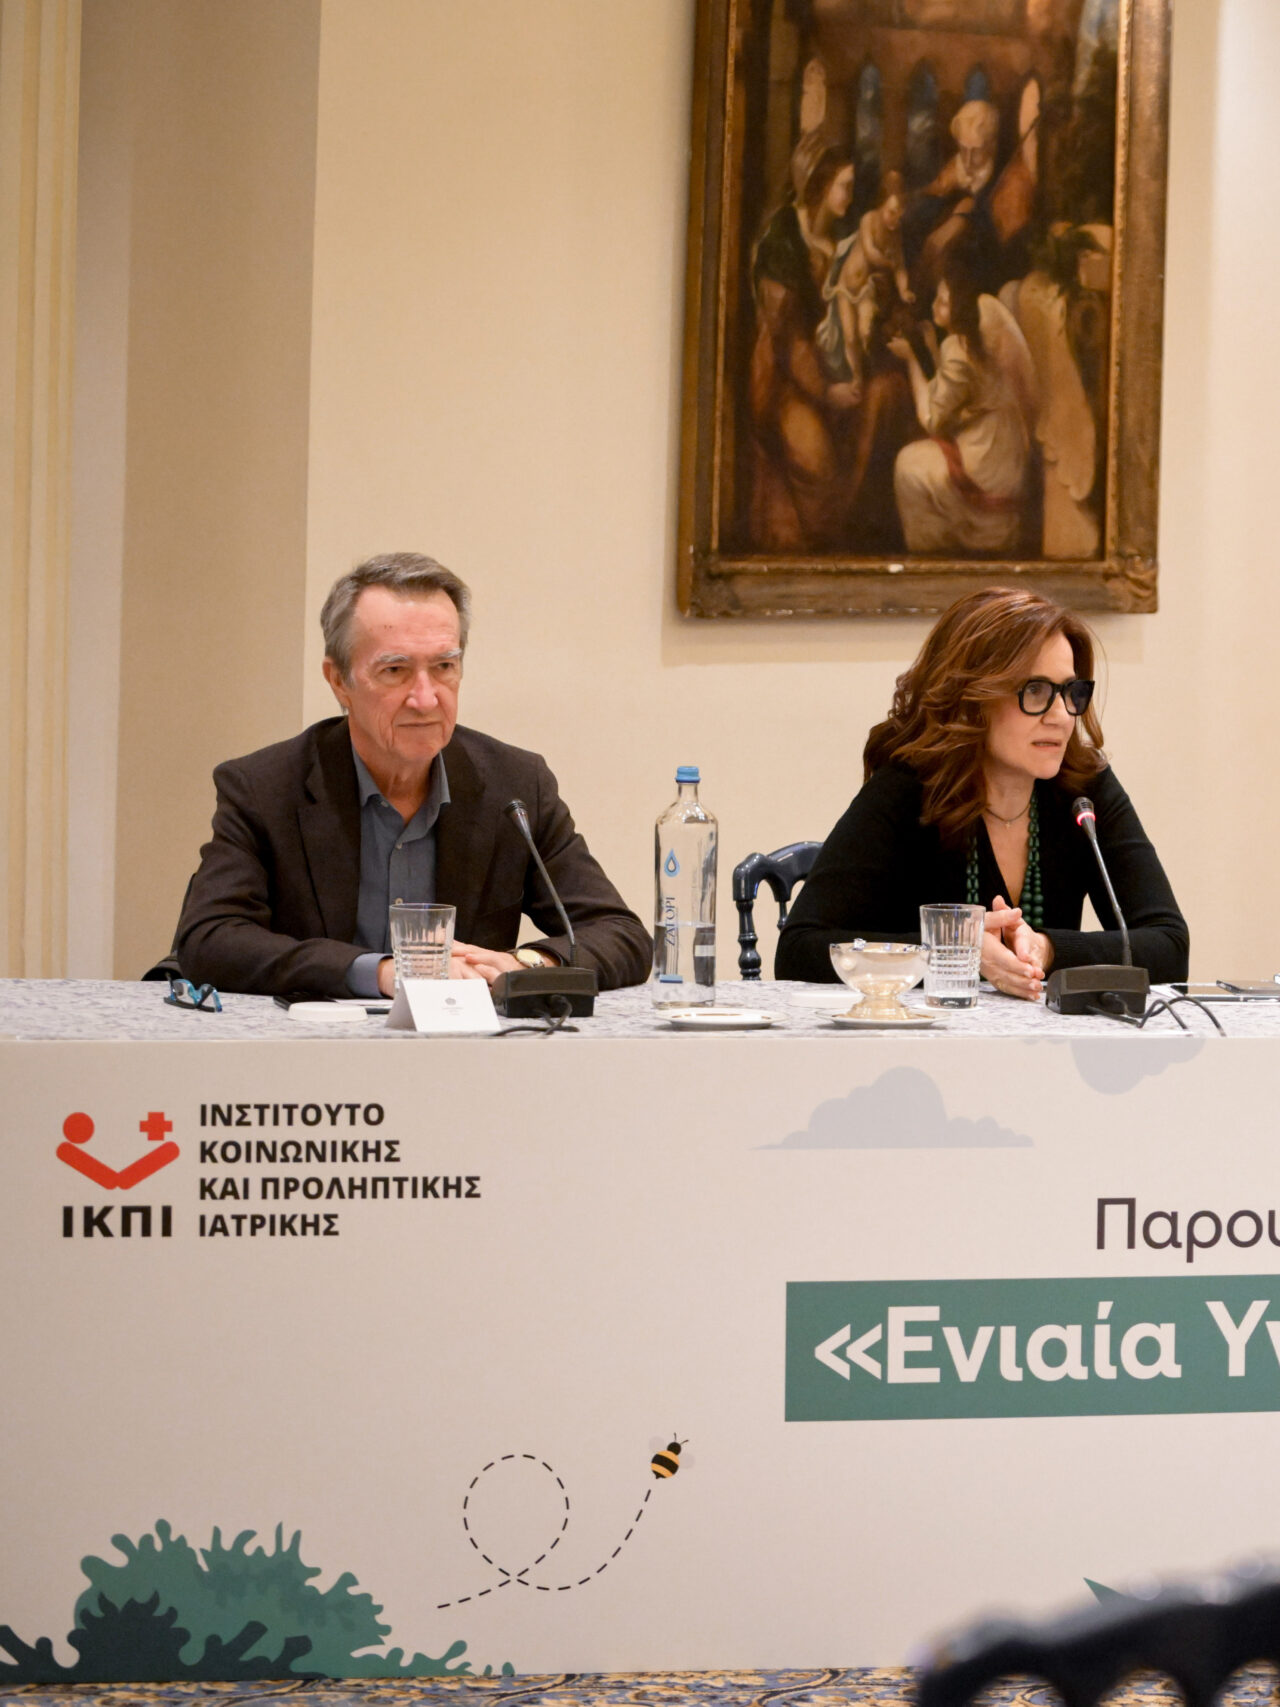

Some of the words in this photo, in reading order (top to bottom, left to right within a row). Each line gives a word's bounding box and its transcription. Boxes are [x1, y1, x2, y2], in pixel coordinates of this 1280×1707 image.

[199, 1102, 385, 1127] ΙΝΣΤΙΤΟΥΤΟ
[199, 1139, 401, 1164] ΚΟΙΝΩΝΙΚΗΣ
[199, 1177, 250, 1201] ΚΑΙ
[260, 1175, 481, 1201] ΠΡΟΛΗΠΤΙΚΗΣ
[61, 1204, 173, 1239] ΙΚΠΙ
[199, 1213, 340, 1238] ΙΑΤΡΙΚΗΣ
[814, 1300, 1182, 1384] «Ενιαία
